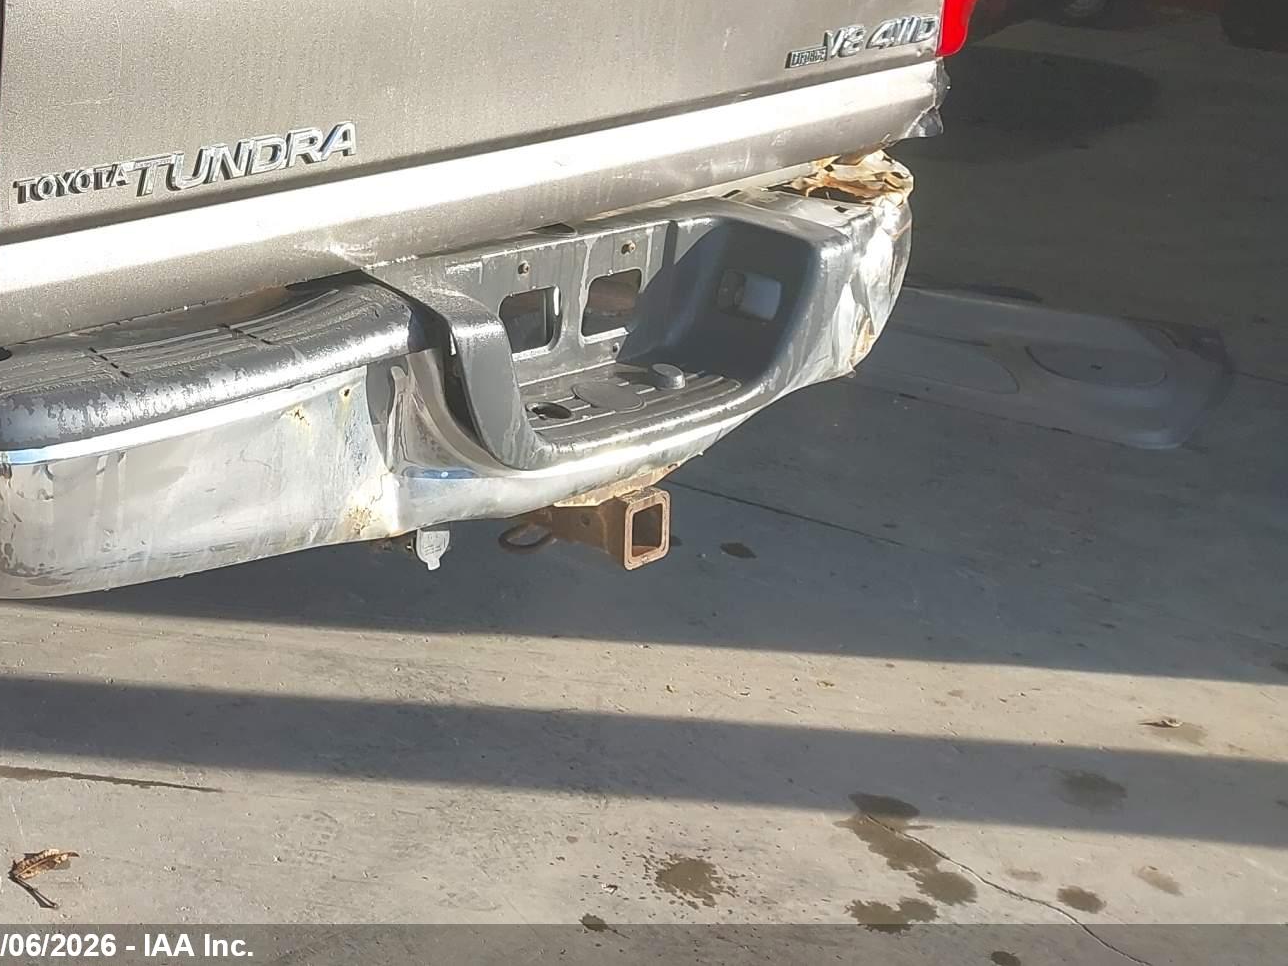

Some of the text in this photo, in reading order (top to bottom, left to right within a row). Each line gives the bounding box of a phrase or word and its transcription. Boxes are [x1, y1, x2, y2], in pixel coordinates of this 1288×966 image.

[825, 26, 866, 58] V8
[866, 16, 939, 50] 4WD
[13, 121, 357, 203] TOYOTA TUNDRA
